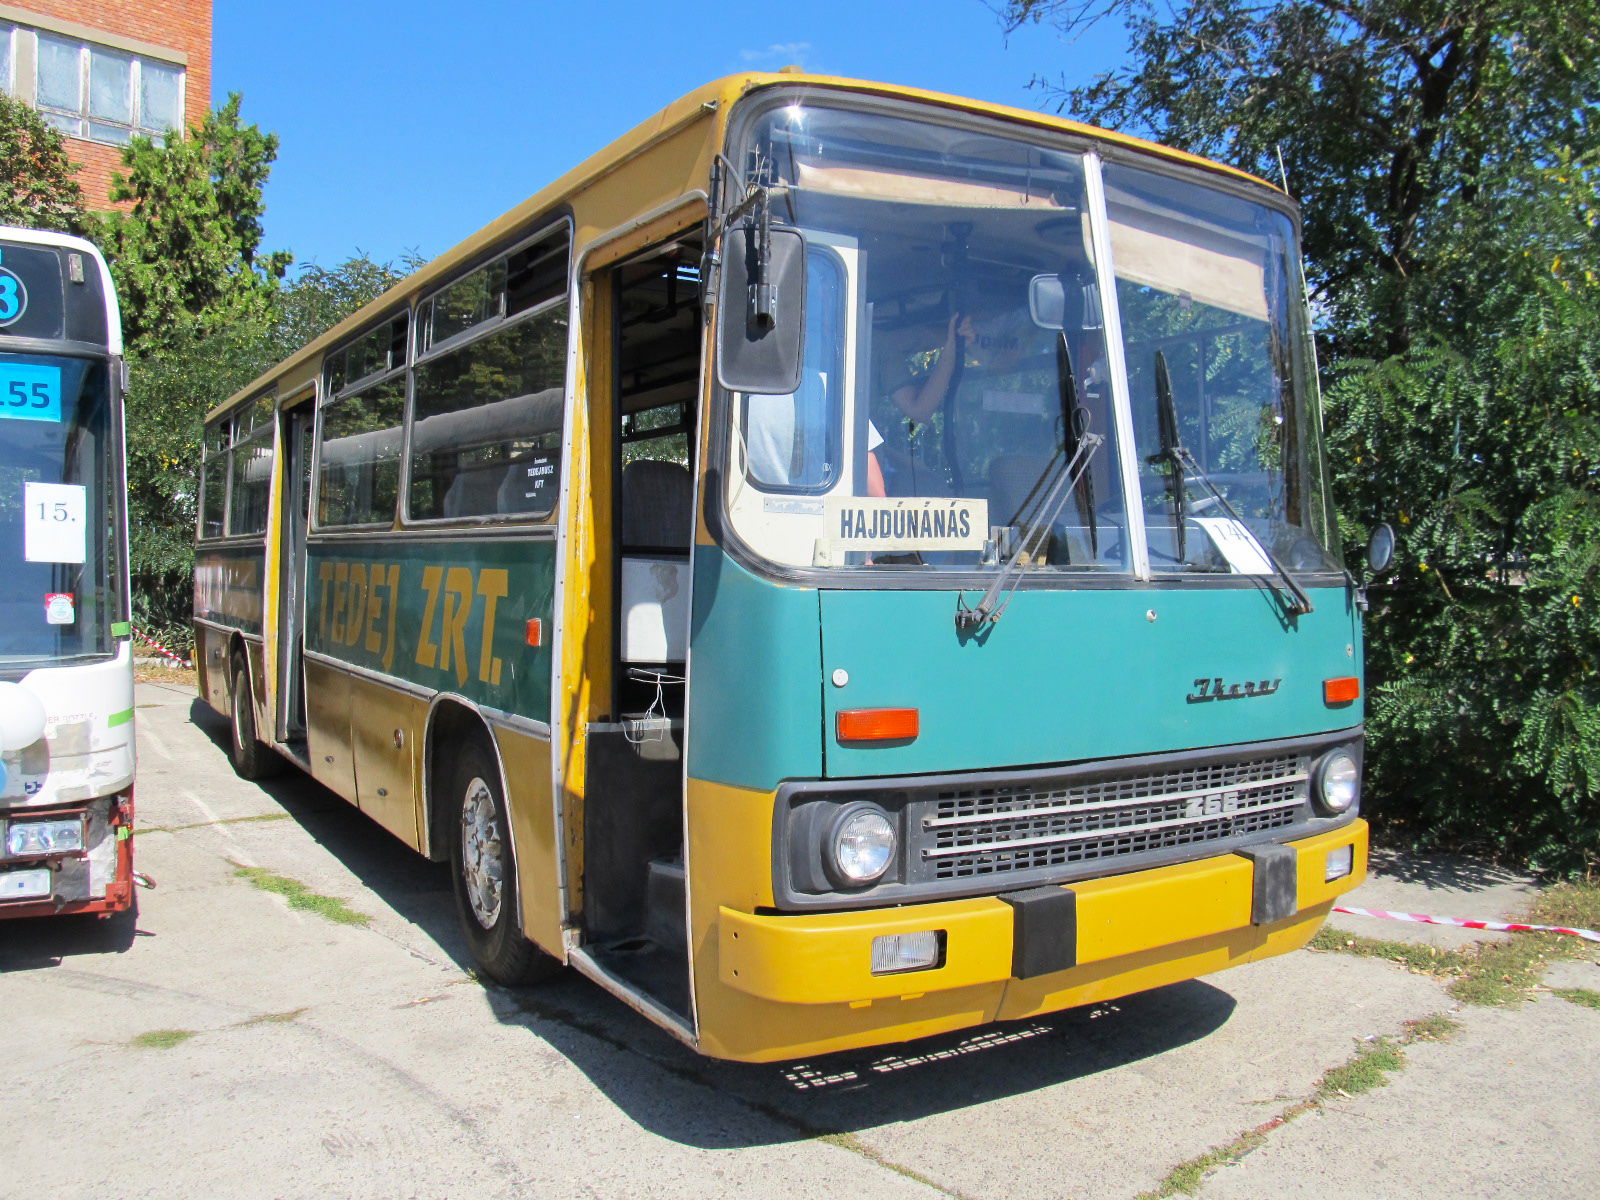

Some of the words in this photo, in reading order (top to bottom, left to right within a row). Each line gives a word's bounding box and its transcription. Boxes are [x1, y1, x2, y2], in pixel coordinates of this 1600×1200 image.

[0, 381, 50, 408] 55
[37, 502, 76, 522] 15.
[841, 501, 971, 538] HAJDÚNÁNÁS
[319, 562, 400, 673] TEDEJ
[415, 566, 509, 688] ZRT.
[1186, 677, 1282, 704] Ikarus
